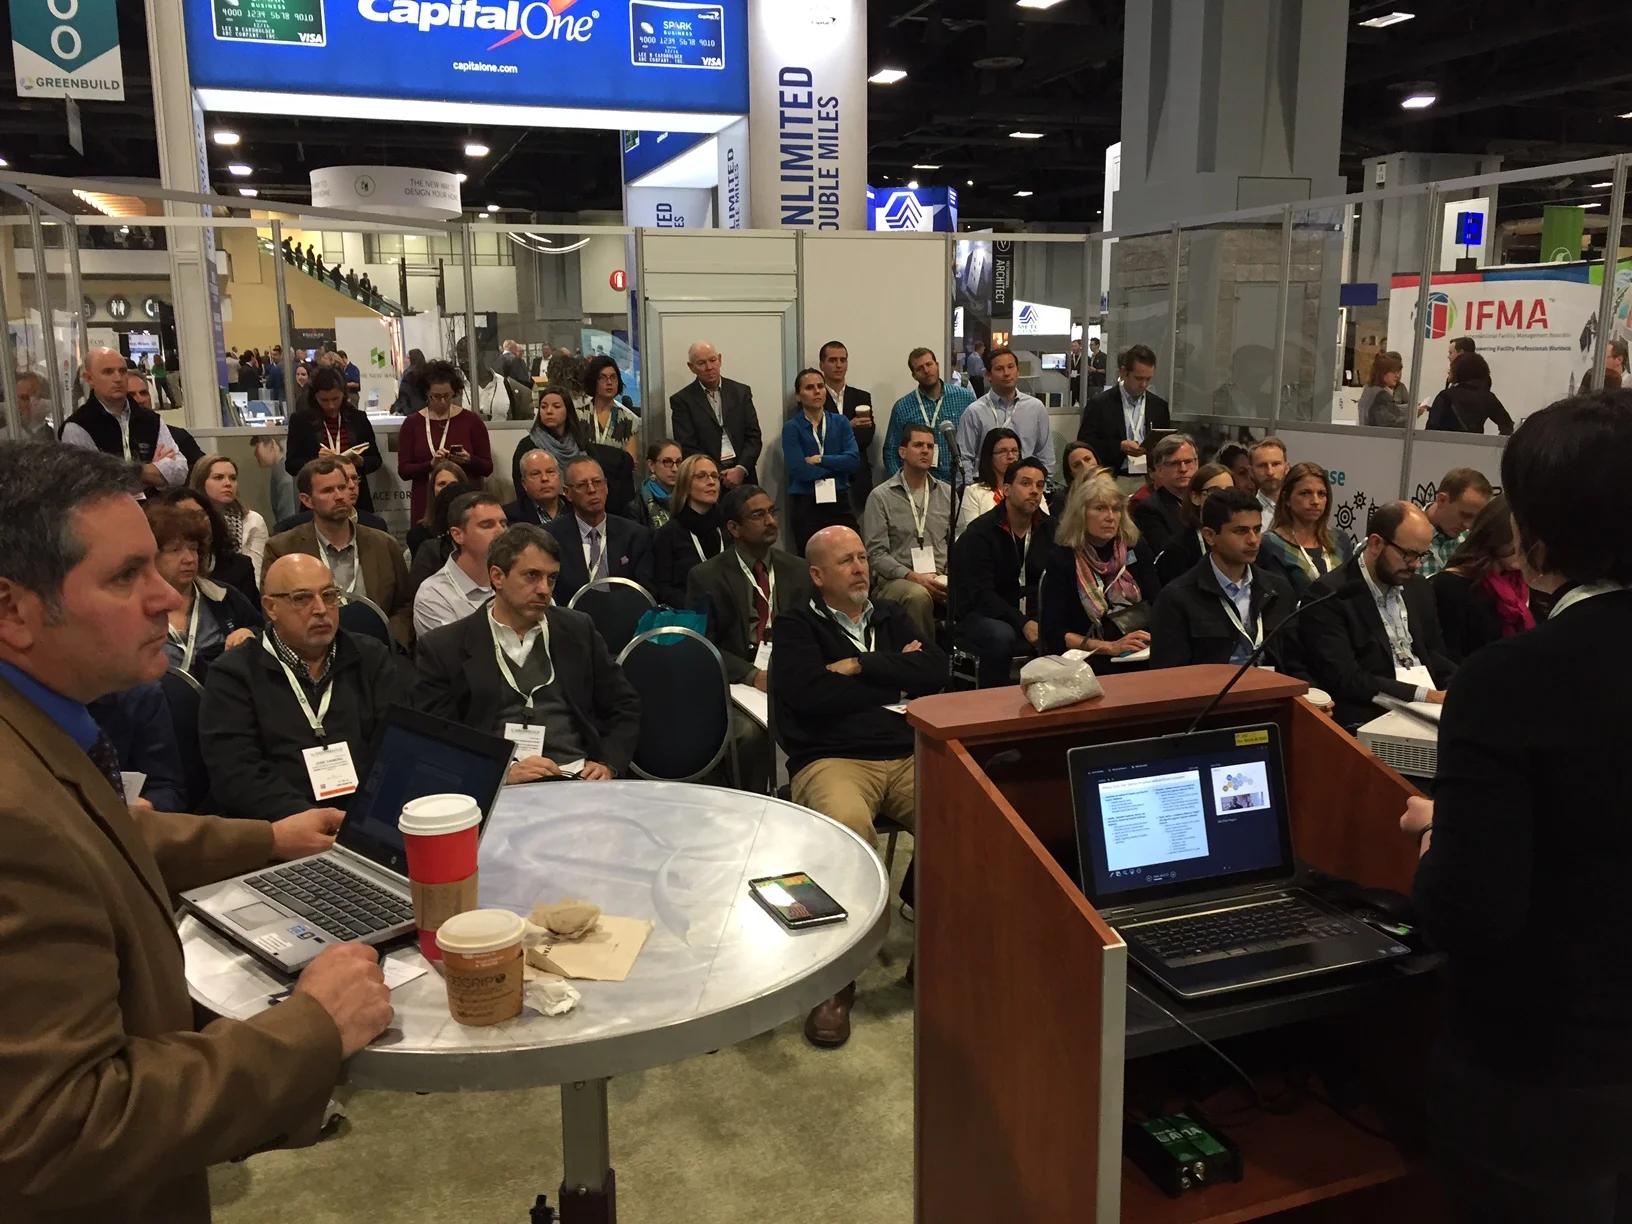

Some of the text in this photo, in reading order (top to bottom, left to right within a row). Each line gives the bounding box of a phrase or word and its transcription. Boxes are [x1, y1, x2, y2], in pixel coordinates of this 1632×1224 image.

[247, 10, 266, 18] 1234
[270, 12, 290, 20] 5678
[294, 13, 314, 22] 9010
[662, 20, 692, 30] SPARK
[298, 32, 322, 43] VISA
[699, 39, 716, 47] 9010
[452, 60, 518, 74] capitalone.com
[701, 57, 722, 66] VISA
[36, 76, 120, 90] GREENBUILD
[817, 96, 839, 160] MILES
[778, 66, 814, 227] NLIMITED
[410, 178, 424, 187] THE
[404, 188, 430, 196] DESIGN
[995, 259, 1005, 304] ARCHITECT
[1464, 298, 1548, 330] IFMA
[373, 491, 412, 500] ACE FOR
